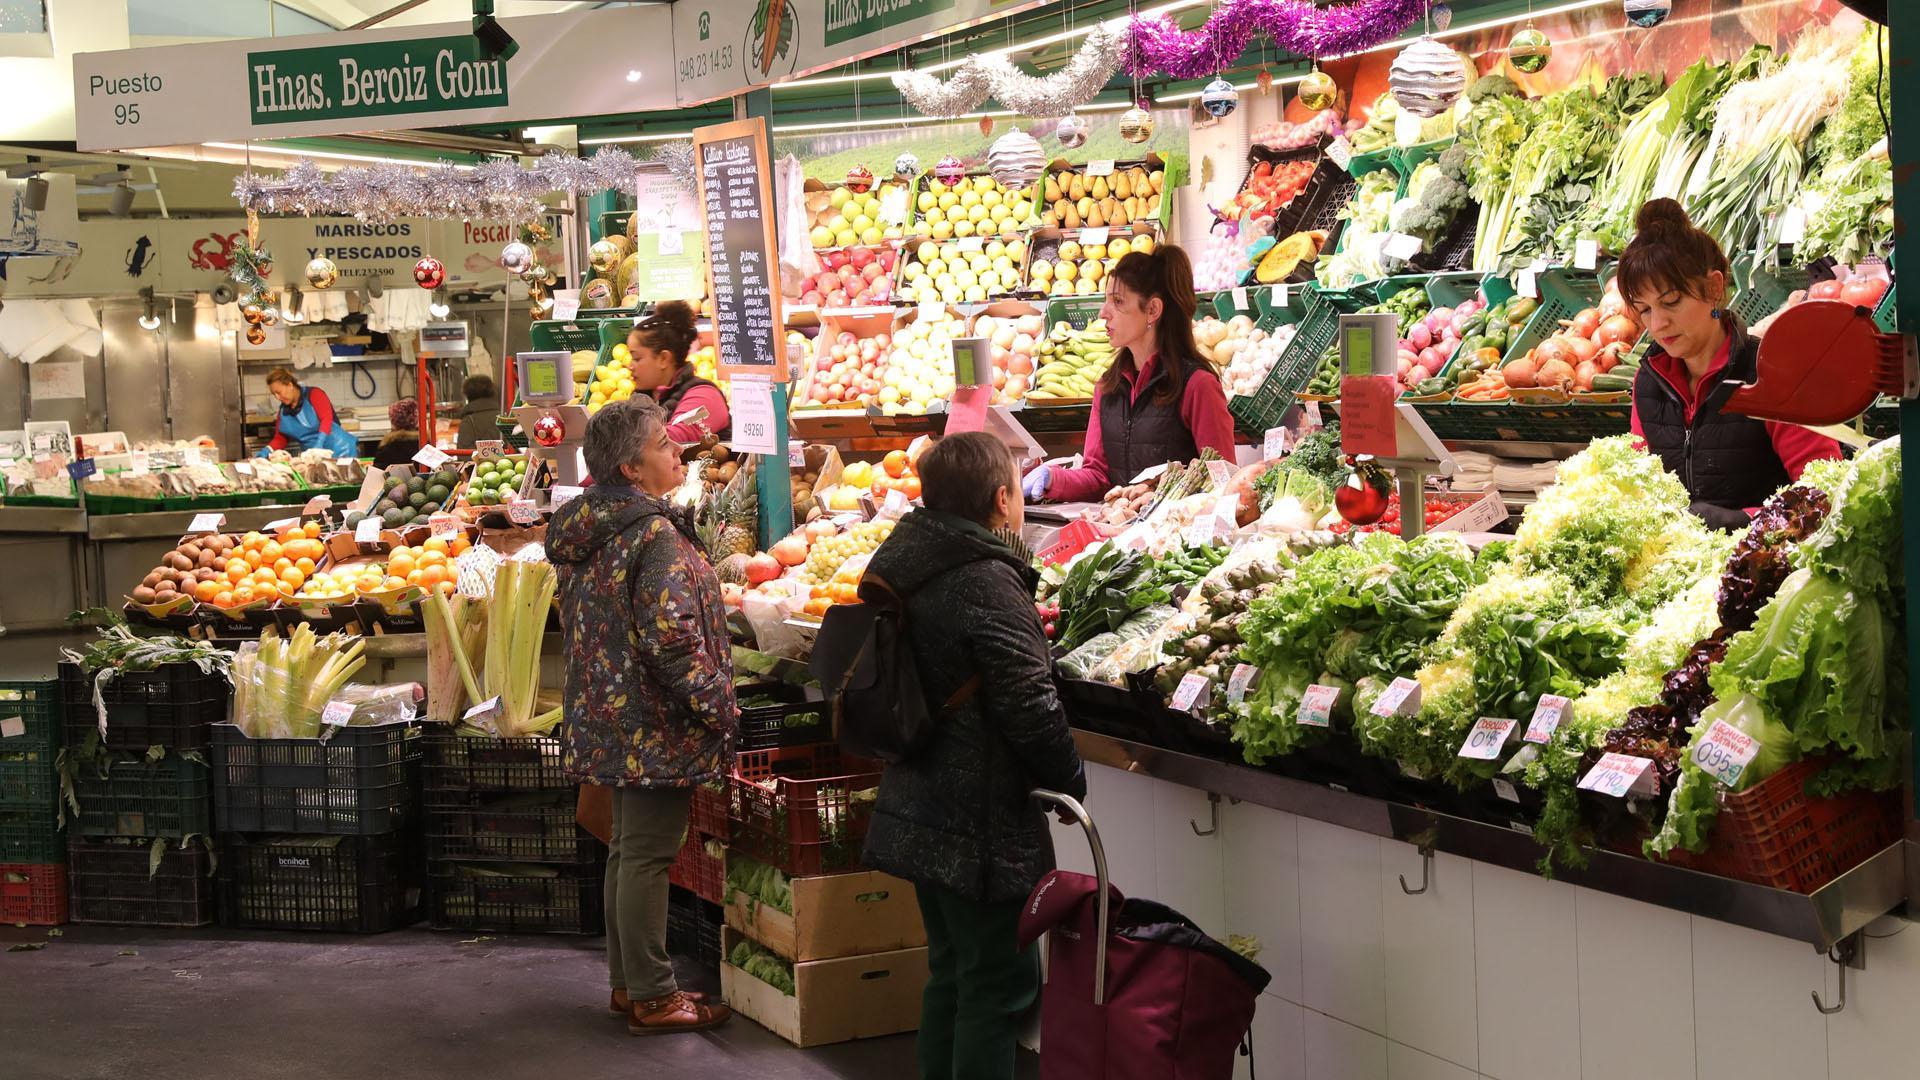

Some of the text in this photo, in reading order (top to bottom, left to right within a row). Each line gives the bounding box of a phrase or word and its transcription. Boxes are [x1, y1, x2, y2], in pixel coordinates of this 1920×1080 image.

[680, 45, 733, 82] 948 23 14 53
[90, 73, 162, 96] Puesto
[254, 64, 332, 112] Hnas.
[339, 53, 428, 106] Beroiz
[114, 104, 140, 125] 95
[315, 223, 411, 238] MARISCOS
[325, 245, 422, 260] PESCADOS
[1277, 345, 1299, 378] JOSETXO
[744, 424, 763, 437] 49260
[1478, 719, 1511, 731] COGOLLOS
[1713, 720, 1752, 747] LECHUGA
[1711, 734, 1744, 756] BATAVIA
[279, 856, 309, 866] benihort
